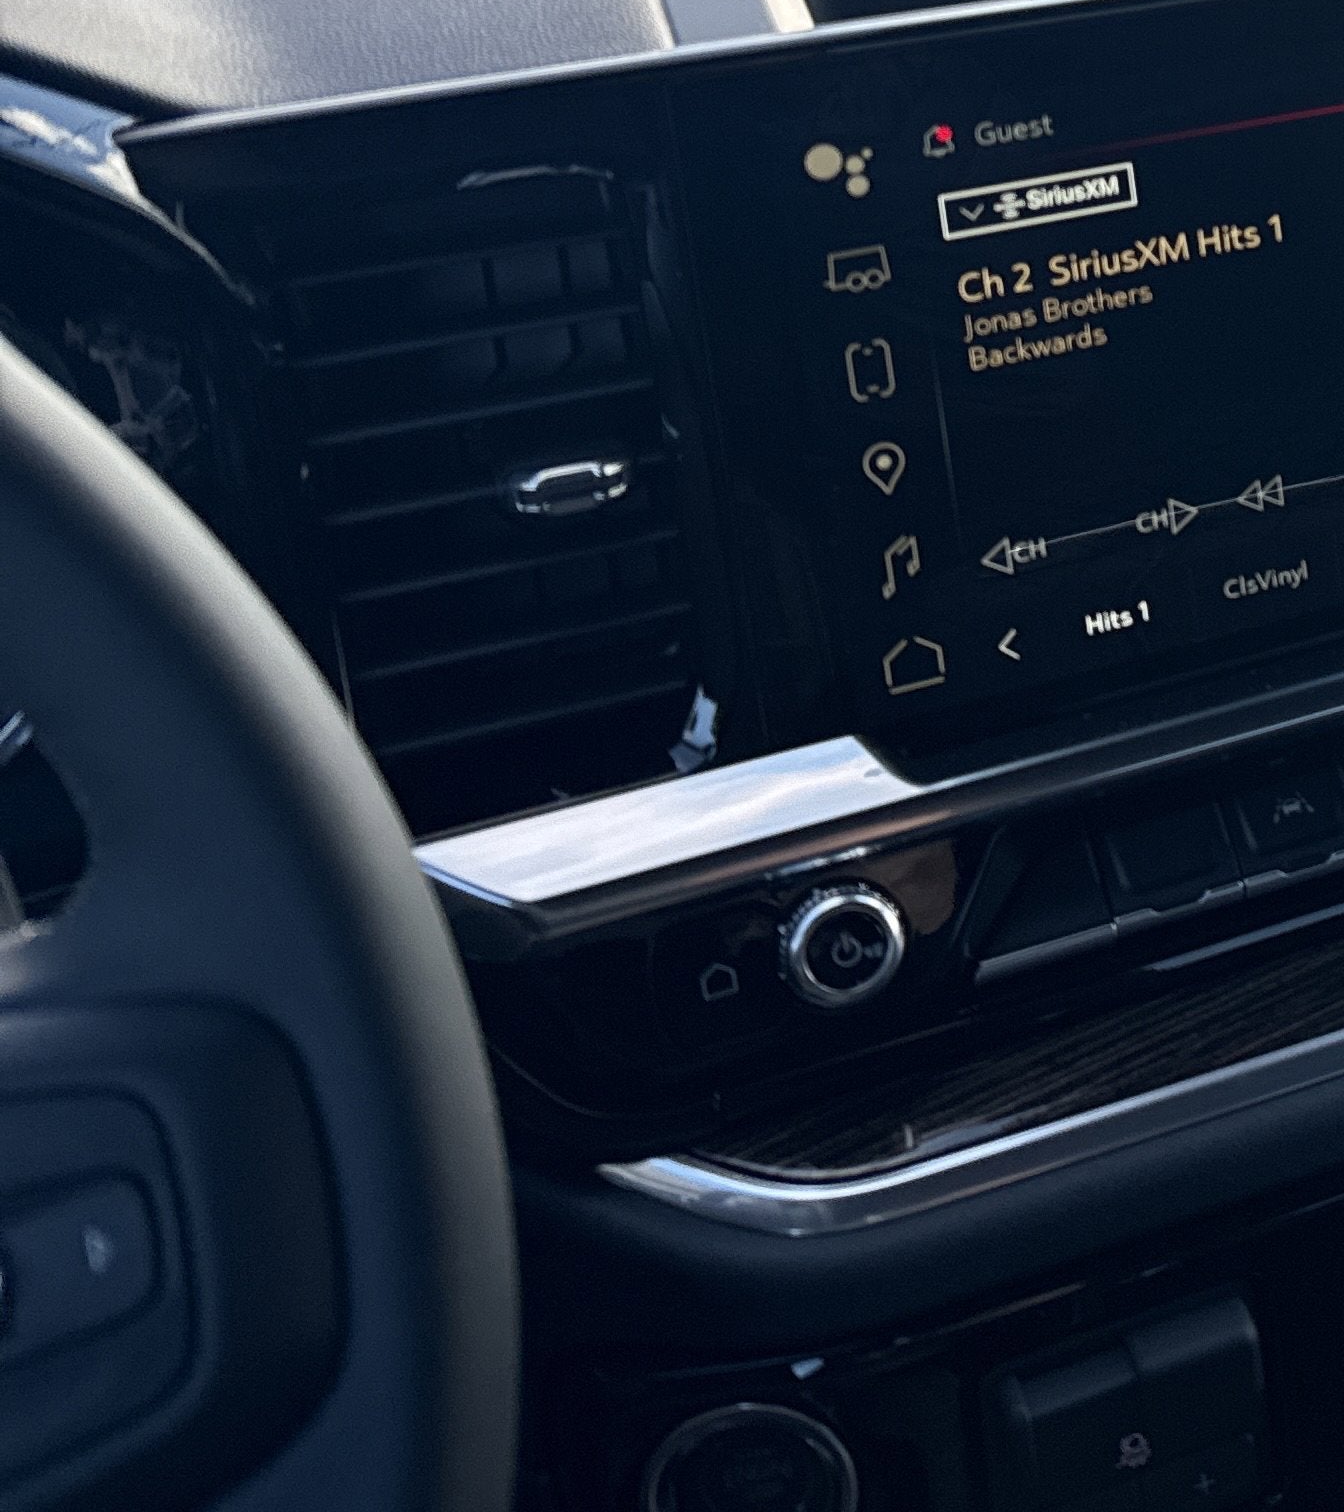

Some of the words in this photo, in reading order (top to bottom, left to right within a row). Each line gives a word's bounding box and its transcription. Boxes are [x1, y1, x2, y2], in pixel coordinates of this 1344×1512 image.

[974, 114, 1054, 147] Guest
[1025, 175, 1119, 211] SiriusXM
[958, 267, 1004, 303] Ch
[1011, 262, 1034, 294] 2
[1049, 231, 1190, 287] SiriusXM
[1196, 224, 1261, 257] Hits
[1267, 213, 1283, 243] 1
[964, 306, 1038, 343] Jonas
[1042, 285, 1153, 323] Brothers
[967, 323, 1108, 372] Backwards
[1134, 507, 1169, 534] CH
[1012, 536, 1047, 563] CH
[1222, 560, 1309, 599] ClsVinyl
[1085, 609, 1133, 636] Hits
[1138, 600, 1151, 622] 1
